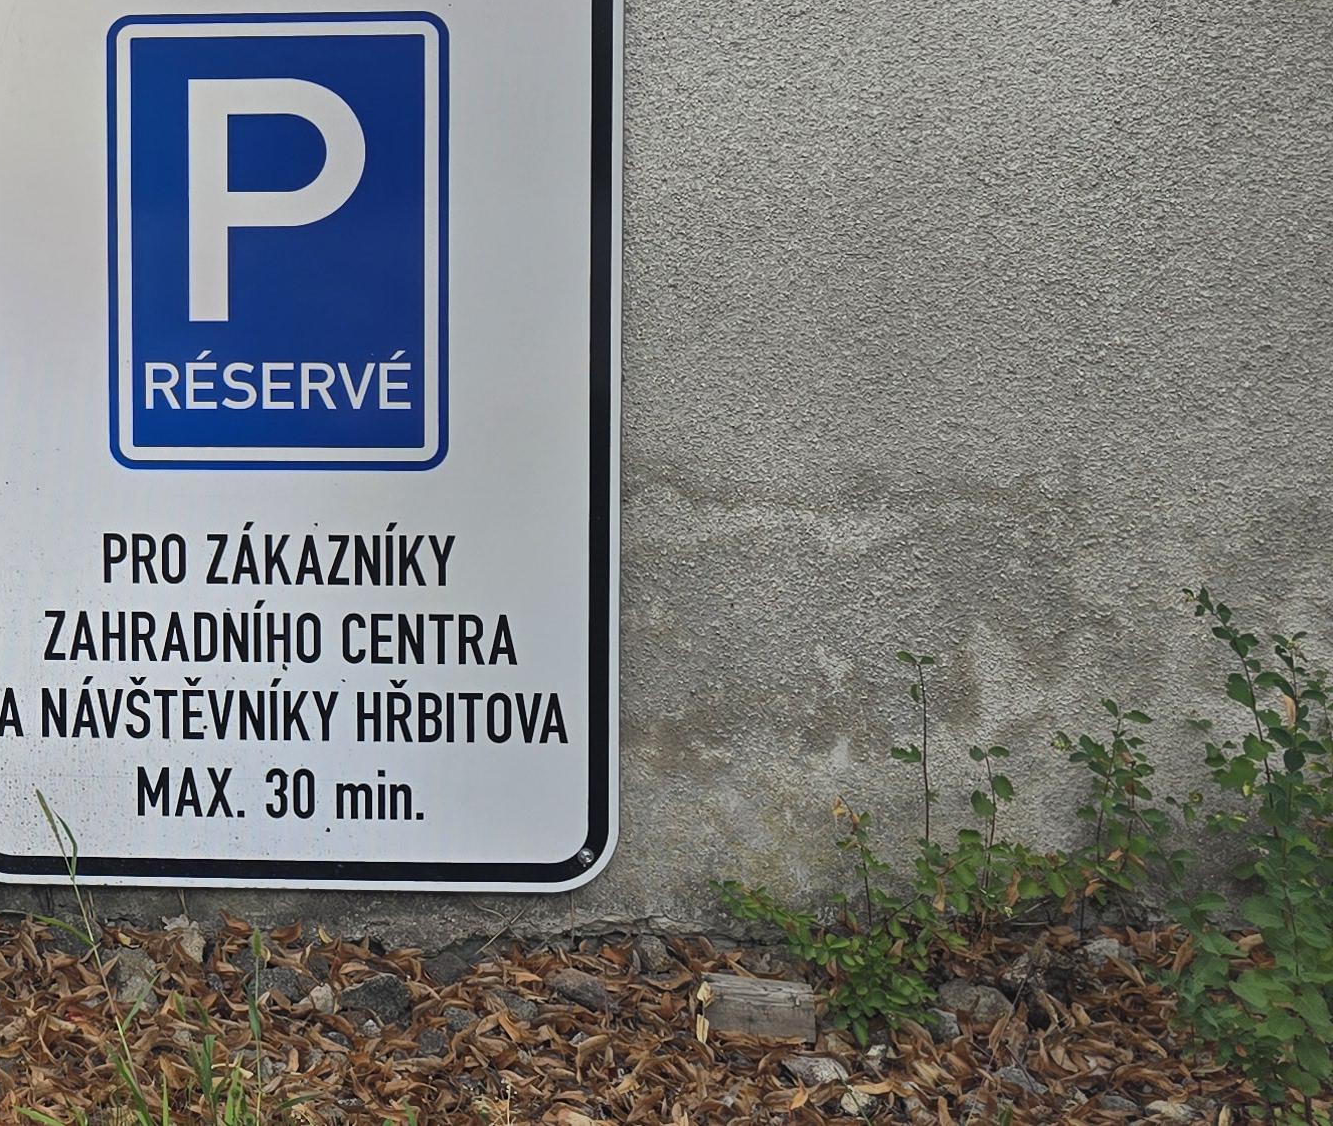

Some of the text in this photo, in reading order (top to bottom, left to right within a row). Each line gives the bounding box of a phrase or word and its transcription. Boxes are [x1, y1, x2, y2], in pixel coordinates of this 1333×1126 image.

[187, 77, 366, 322] P
[144, 350, 412, 410] RÉSERVÉ
[103, 521, 456, 587] PRO ZÁKAZNÍKY
[45, 600, 518, 666] ZAHRADNÍHO CENTRA
[41, 675, 339, 742] NÁVŠTĚVNÍKY
[356, 679, 569, 744] HŘBITOVA
[137, 766, 424, 821] MAX. 30 min.
